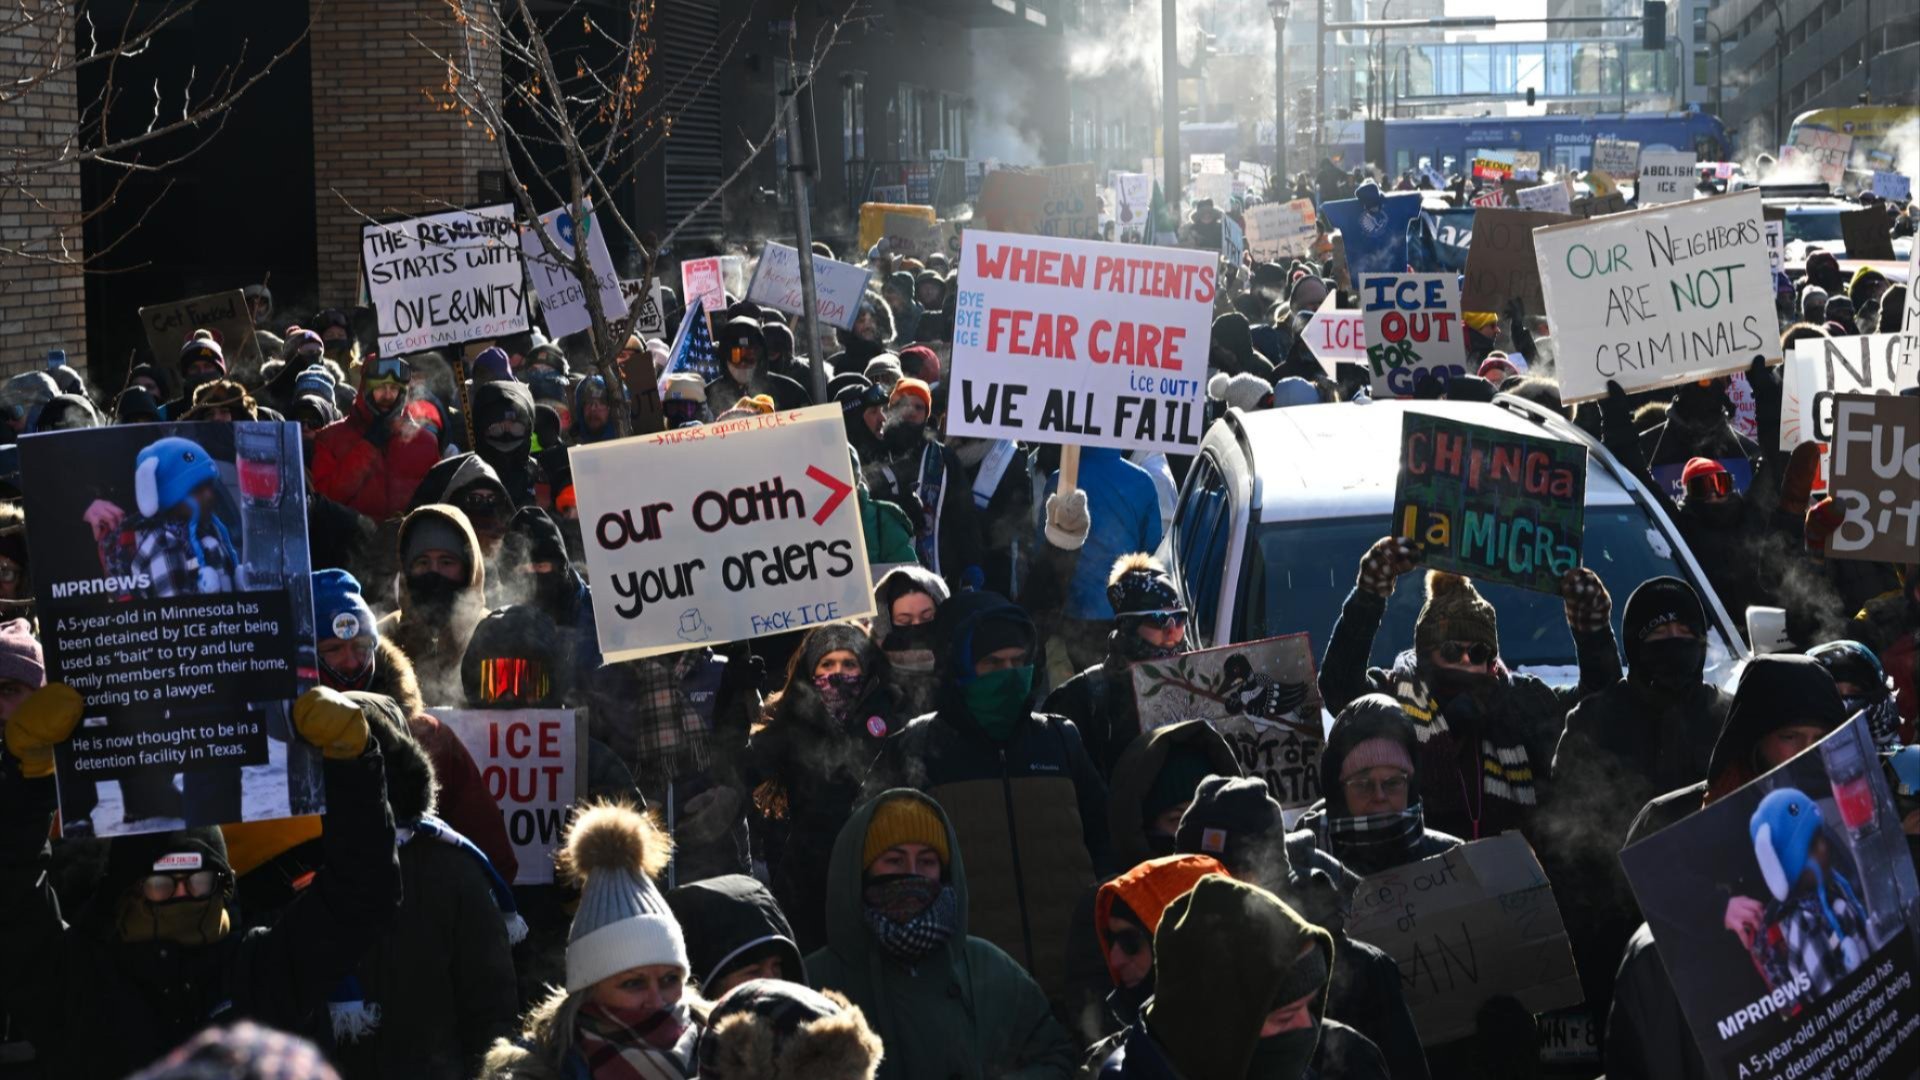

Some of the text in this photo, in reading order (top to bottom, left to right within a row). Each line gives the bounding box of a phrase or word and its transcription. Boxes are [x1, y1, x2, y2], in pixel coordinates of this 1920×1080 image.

[1643, 165, 1693, 176] ABOLISH
[1657, 182, 1676, 192] ICE
[365, 230, 407, 257] THE
[371, 247, 521, 284] STARTS WITH
[976, 243, 1216, 304] WHEN PATIENTS
[1567, 243, 1632, 280] OUR
[540, 272, 617, 312] NEIGHRS
[779, 290, 845, 320] AGNDA
[959, 291, 984, 308] BYE
[1365, 277, 1447, 312] ICE
[1606, 264, 1745, 327] ARE NOT
[957, 310, 982, 328] BYE
[1321, 319, 1366, 350] ICE
[1381, 311, 1456, 343] OUT
[384, 340, 403, 352] ICE
[405, 335, 429, 348] OUT
[431, 330, 457, 342] MN
[463, 327, 482, 338] ICE
[484, 321, 508, 333] OUT
[956, 331, 978, 347] ICE
[986, 308, 1187, 371] FEAR CARE
[1596, 315, 1763, 377] CRIMINALS
[1367, 340, 1423, 378] FOR
[1160, 378, 1199, 402] OUT!
[961, 379, 1199, 446] WE ALL FAIL
[664, 415, 783, 445] nurses against ICE
[595, 502, 674, 551] our
[611, 539, 853, 620] your orders
[56, 601, 259, 633] A 5-year-old in Minnesota has
[797, 601, 841, 624] ICE
[58, 619, 279, 651] been detained by ICE after being
[61, 654, 92, 670] used
[96, 654, 112, 666] as
[158, 647, 173, 659] to
[177, 645, 197, 660] try
[200, 641, 227, 656] and
[229, 640, 255, 653] lure
[63, 658, 288, 689] family members from their home,
[134, 689, 149, 701] to
[153, 688, 162, 698] a
[166, 683, 215, 699] lawyer.
[72, 722, 258, 751] He is now thought to be in a
[489, 722, 561, 759] ICE
[1284, 738, 1319, 766] OF
[74, 743, 247, 771] detention facility in Texas.
[482, 766, 564, 803] OUT
[501, 808, 572, 847] OW
[1414, 854, 1459, 891] out
[1397, 903, 1417, 933] of
[1737, 959, 1894, 1080] A 5-year-old in Minnesota has
[1785, 970, 1912, 1080] detained by ICE after being
[1837, 1053, 1849, 1071] to
[1850, 1038, 1865, 1061] try
[1864, 1026, 1882, 1051] and
[1881, 1008, 1899, 1032] lure
[1855, 1050, 1878, 1080] from
[1877, 1038, 1897, 1064] their
